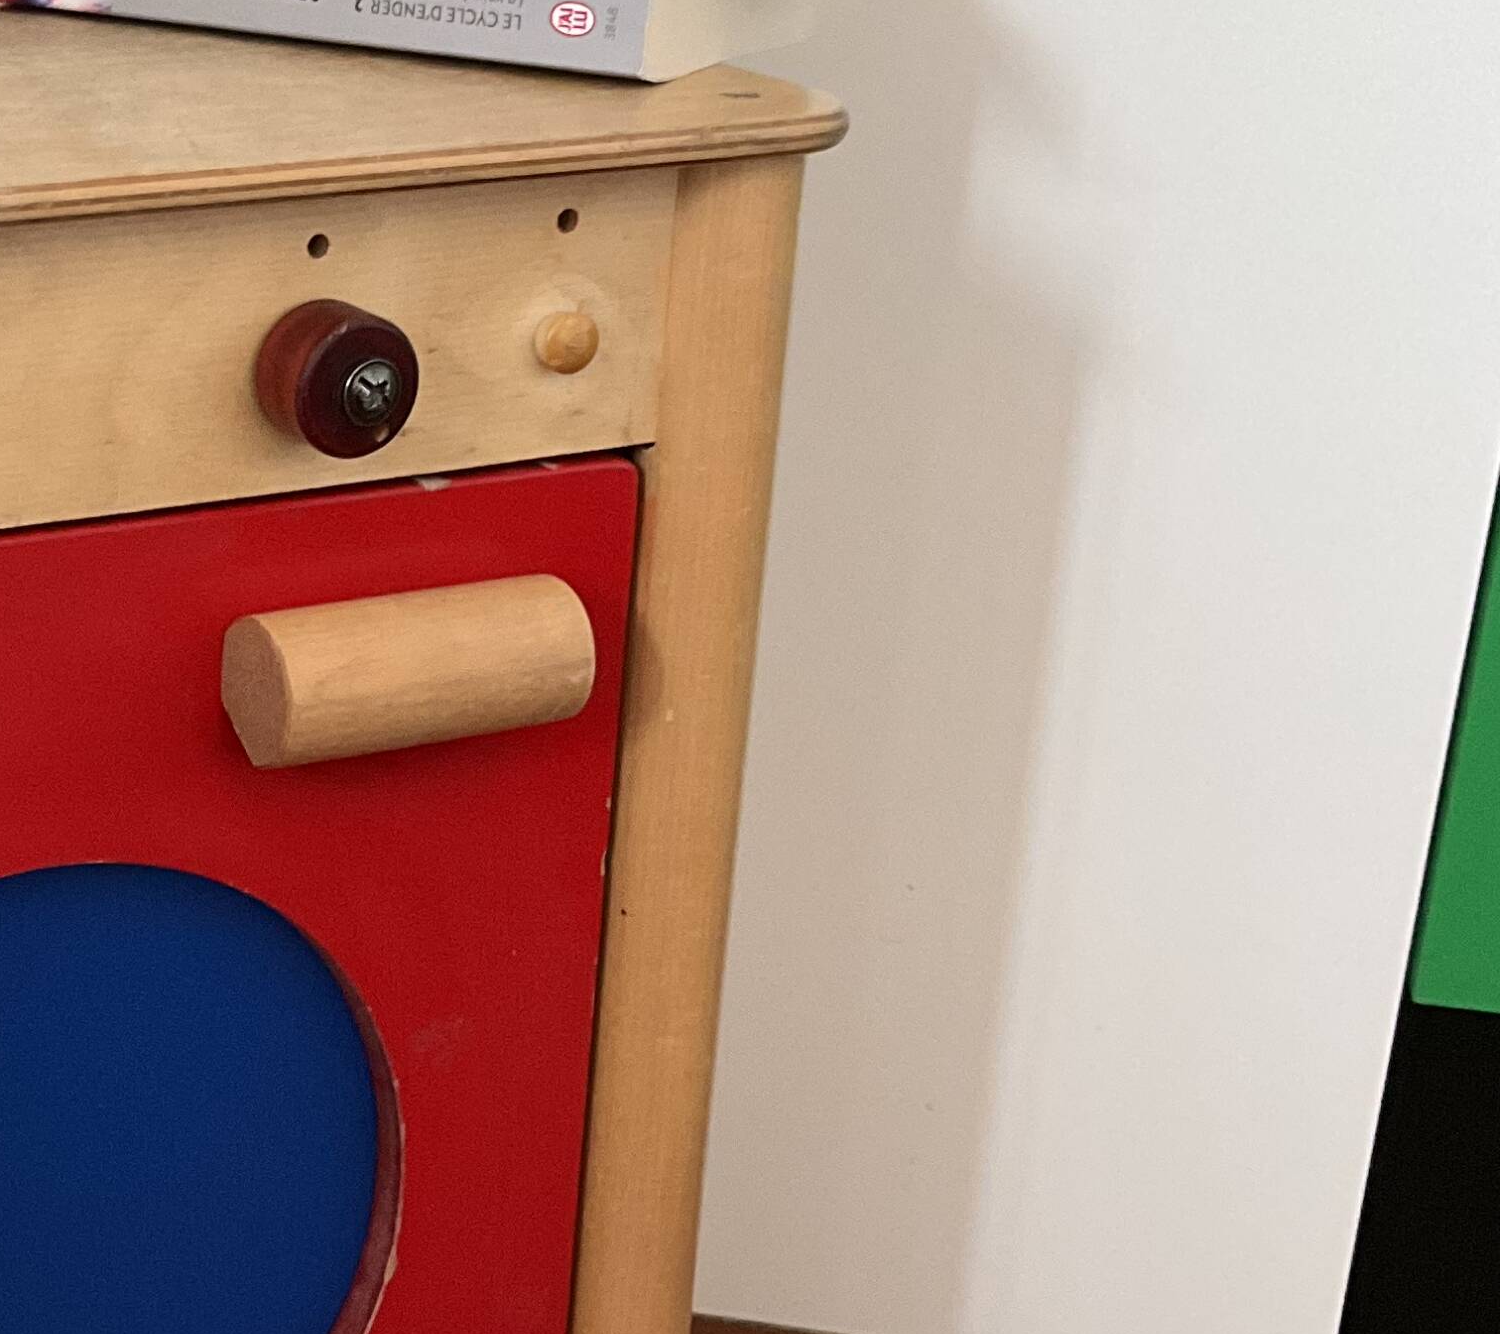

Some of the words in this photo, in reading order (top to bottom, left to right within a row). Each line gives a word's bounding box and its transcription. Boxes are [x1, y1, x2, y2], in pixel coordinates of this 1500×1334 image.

[447, 6, 499, 28] CYCLE
[503, 13, 522, 31] LE
[573, 10, 588, 30] LU
